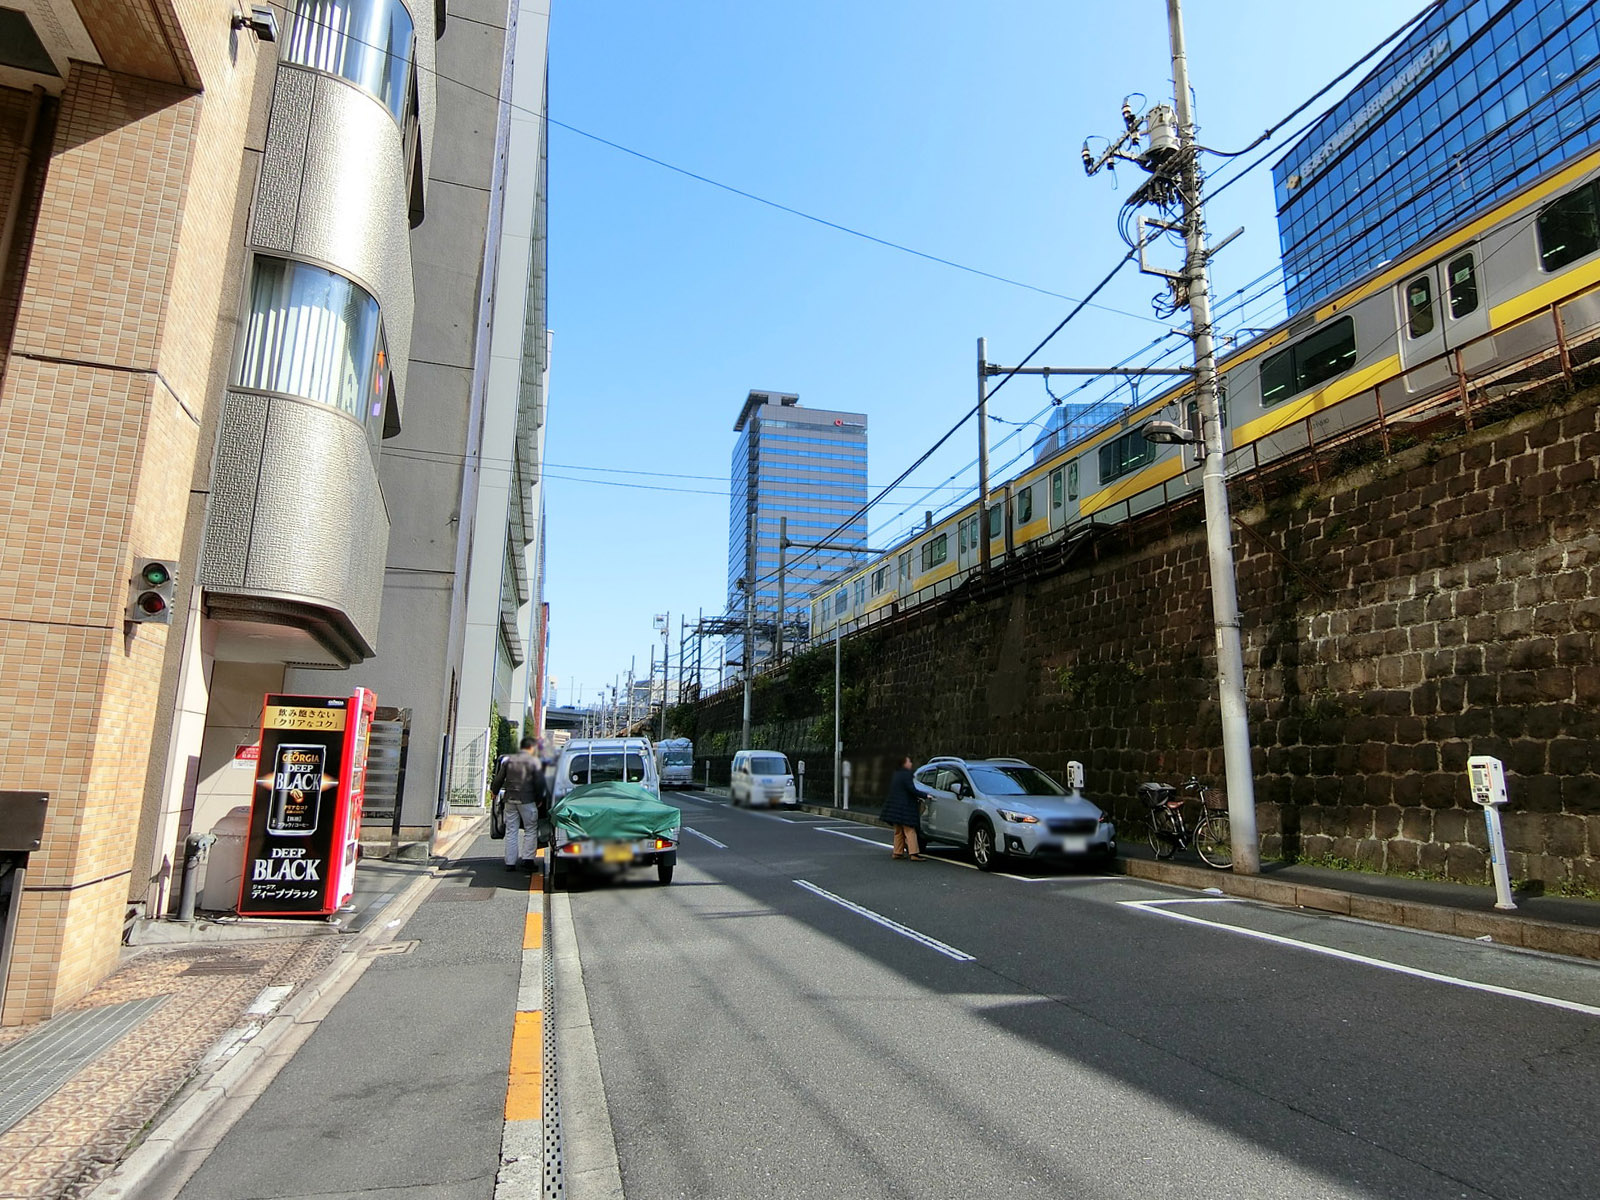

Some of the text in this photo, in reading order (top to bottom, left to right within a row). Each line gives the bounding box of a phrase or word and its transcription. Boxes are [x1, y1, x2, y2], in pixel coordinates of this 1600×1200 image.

[278, 708, 336, 719] 飲み飽きない
[282, 752, 320, 762] GEORGIA
[287, 764, 314, 773] DEEP
[275, 772, 322, 791] BLACK
[271, 847, 307, 858] DEEP
[251, 858, 322, 881] BLACK
[251, 888, 318, 899] ディープブラック
